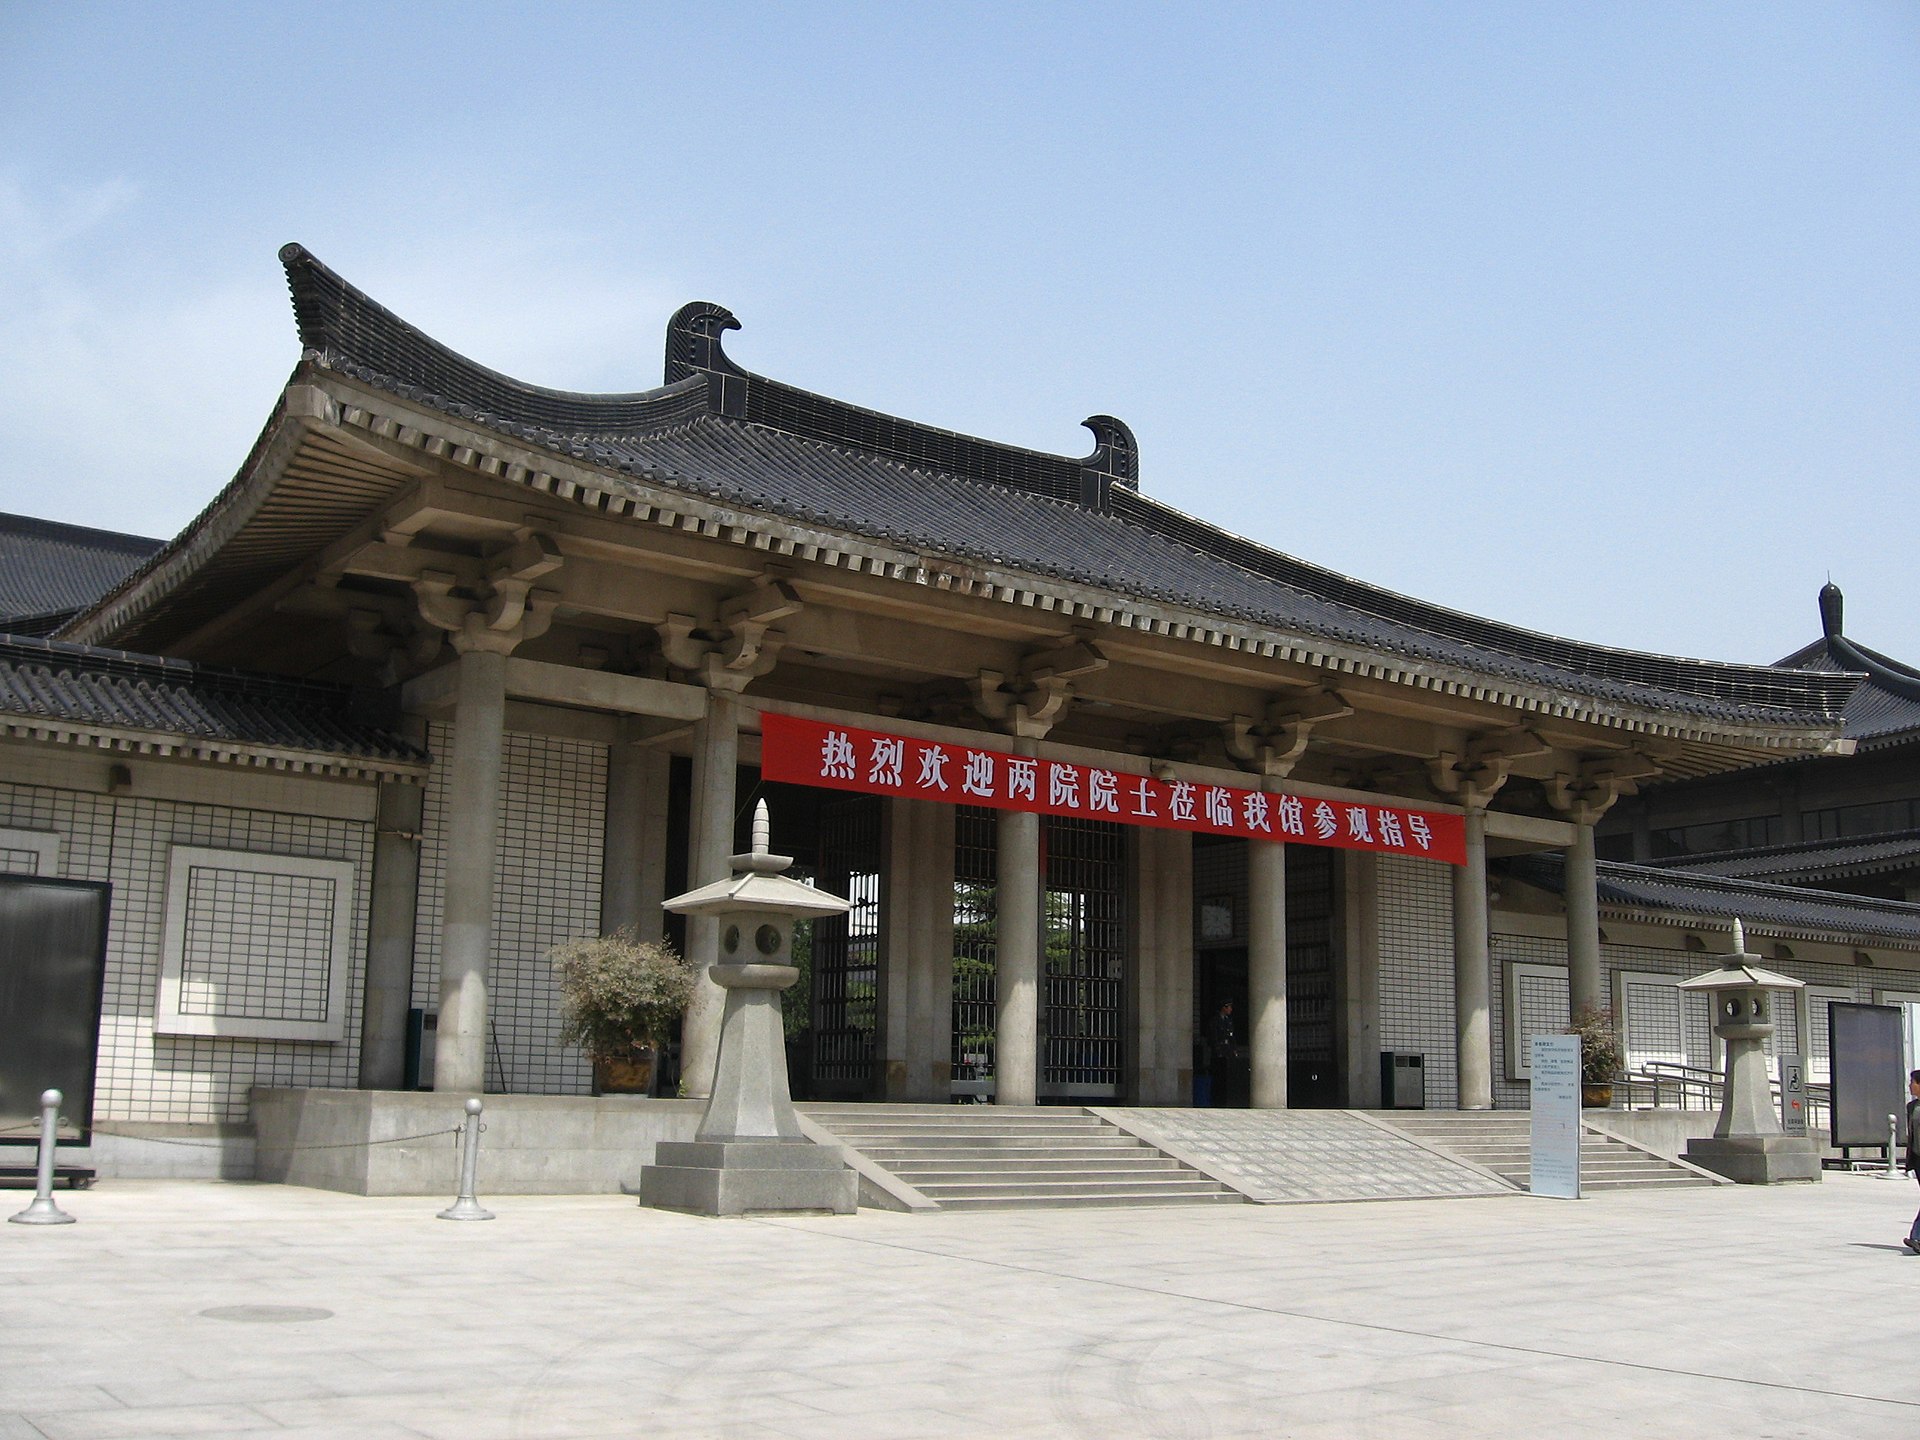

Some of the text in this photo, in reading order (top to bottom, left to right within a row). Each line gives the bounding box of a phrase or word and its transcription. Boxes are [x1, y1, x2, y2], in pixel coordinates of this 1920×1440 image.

[820, 730, 1433, 851] 热烈欢迎两院院士莅临我馆参观指导
